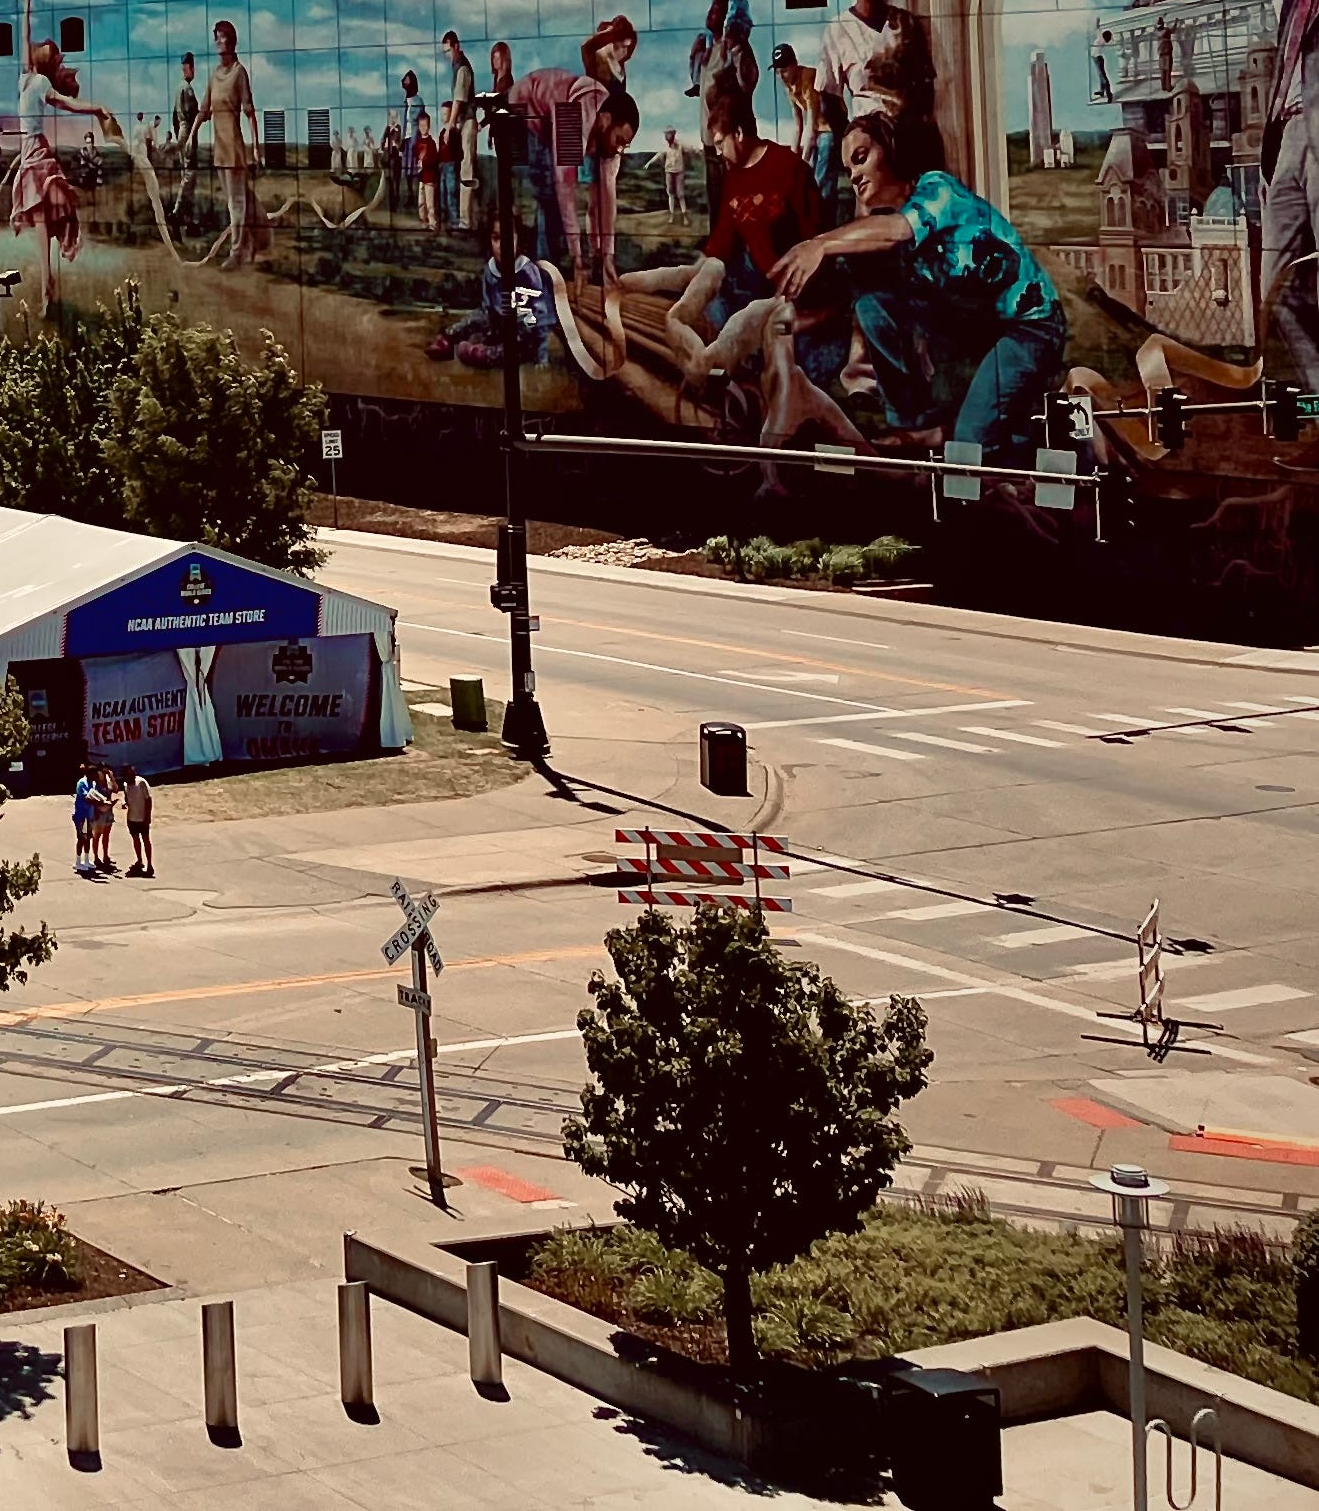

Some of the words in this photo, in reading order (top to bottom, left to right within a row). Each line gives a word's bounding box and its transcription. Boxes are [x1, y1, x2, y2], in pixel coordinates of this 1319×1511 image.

[324, 445, 341, 457] 25
[126, 617, 154, 633] NCAA
[154, 613, 207, 631] AUTHENTIC
[207, 611, 234, 627] TEAM
[234, 608, 266, 625] STORE
[91, 700, 128, 720] NCAA
[127, 688, 186, 715] AUTHENT
[236, 694, 344, 718] WELCOME
[91, 720, 143, 747] TEAM
[146, 711, 186, 740] STO
[383, 893, 438, 961] CROSSING
